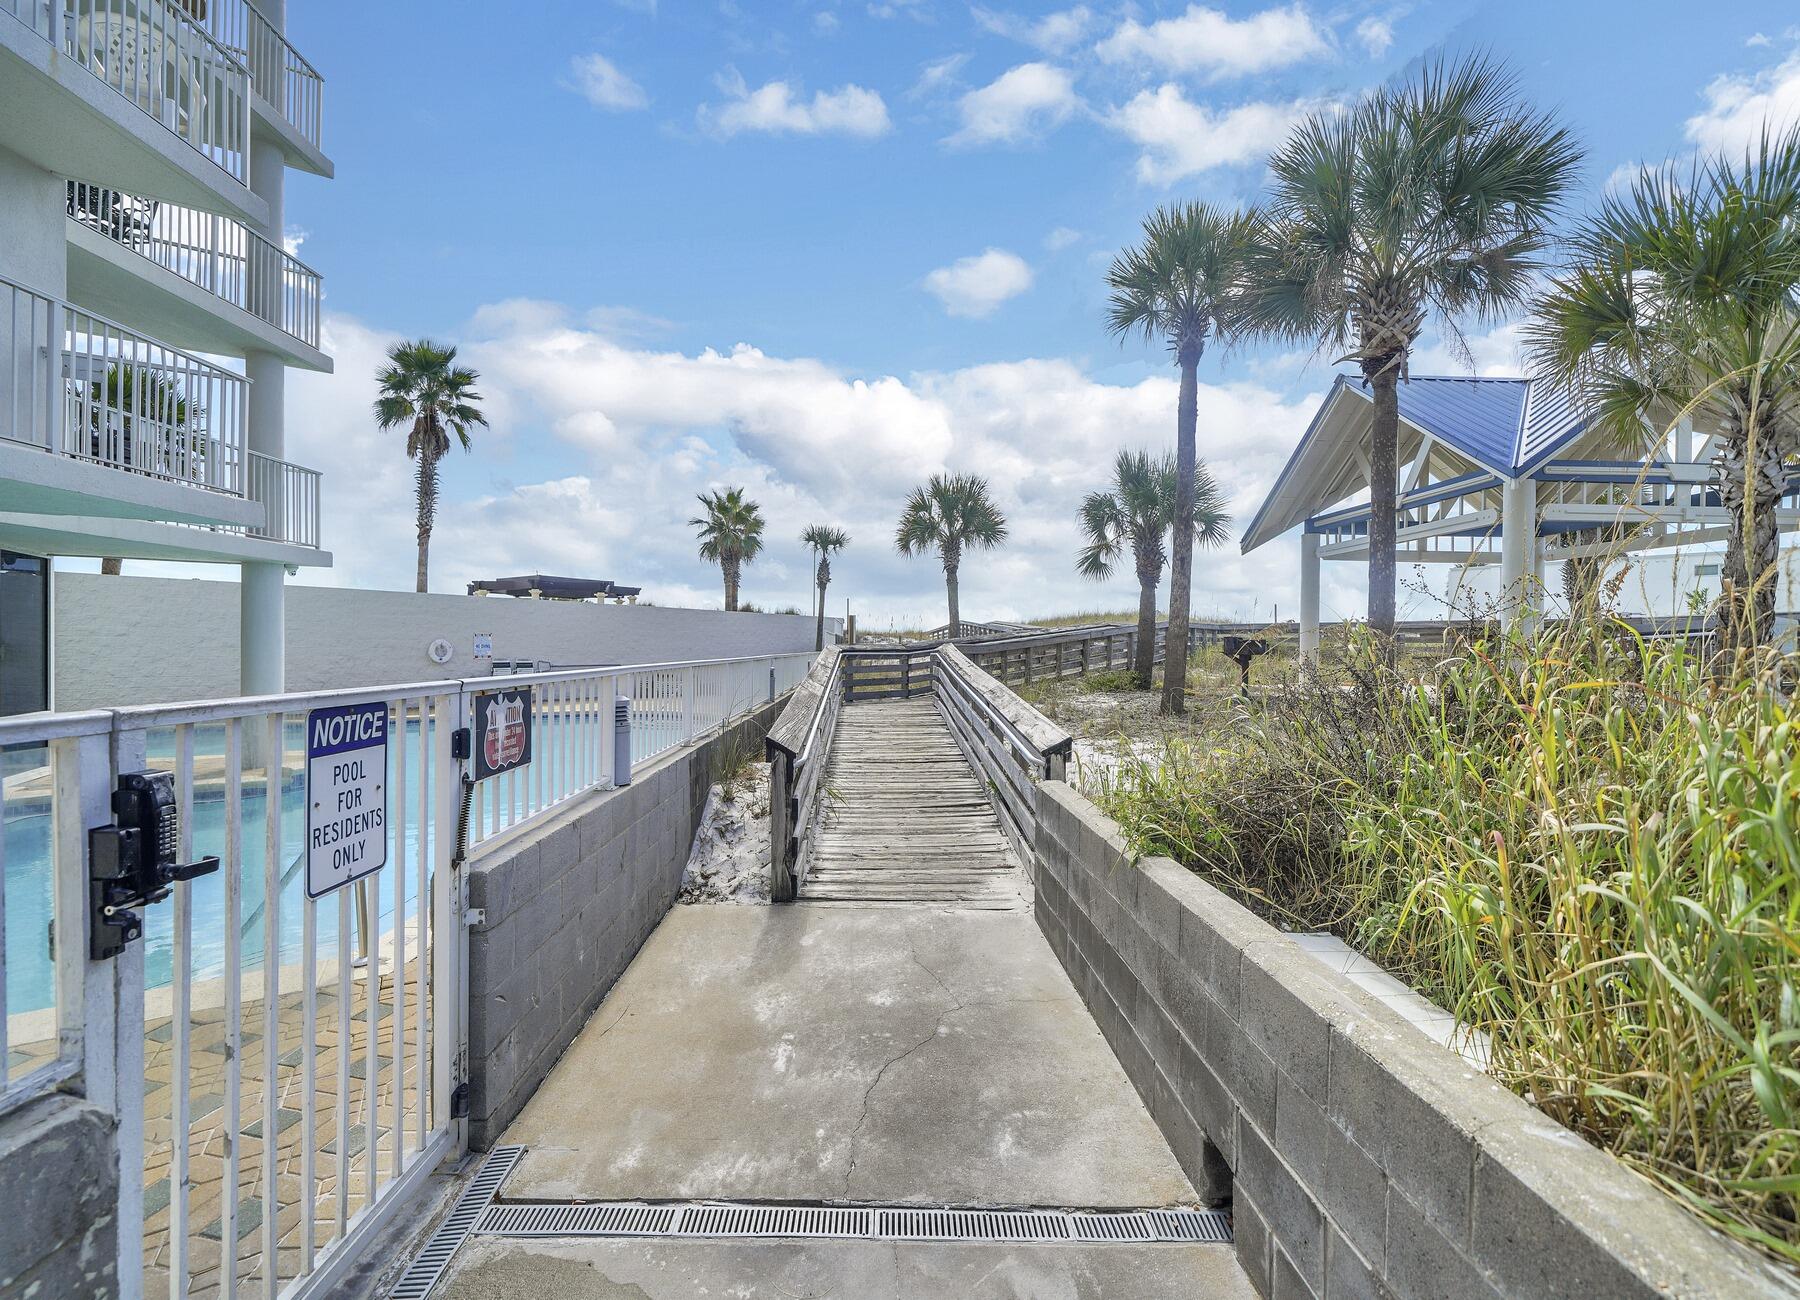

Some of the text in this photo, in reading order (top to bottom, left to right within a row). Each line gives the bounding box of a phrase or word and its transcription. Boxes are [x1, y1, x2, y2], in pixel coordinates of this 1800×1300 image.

[313, 710, 385, 748] NOTICE
[333, 759, 366, 786] POOL
[338, 787, 362, 813] FOR
[313, 807, 383, 849] RESIDENTS
[333, 839, 366, 870] ONLY
